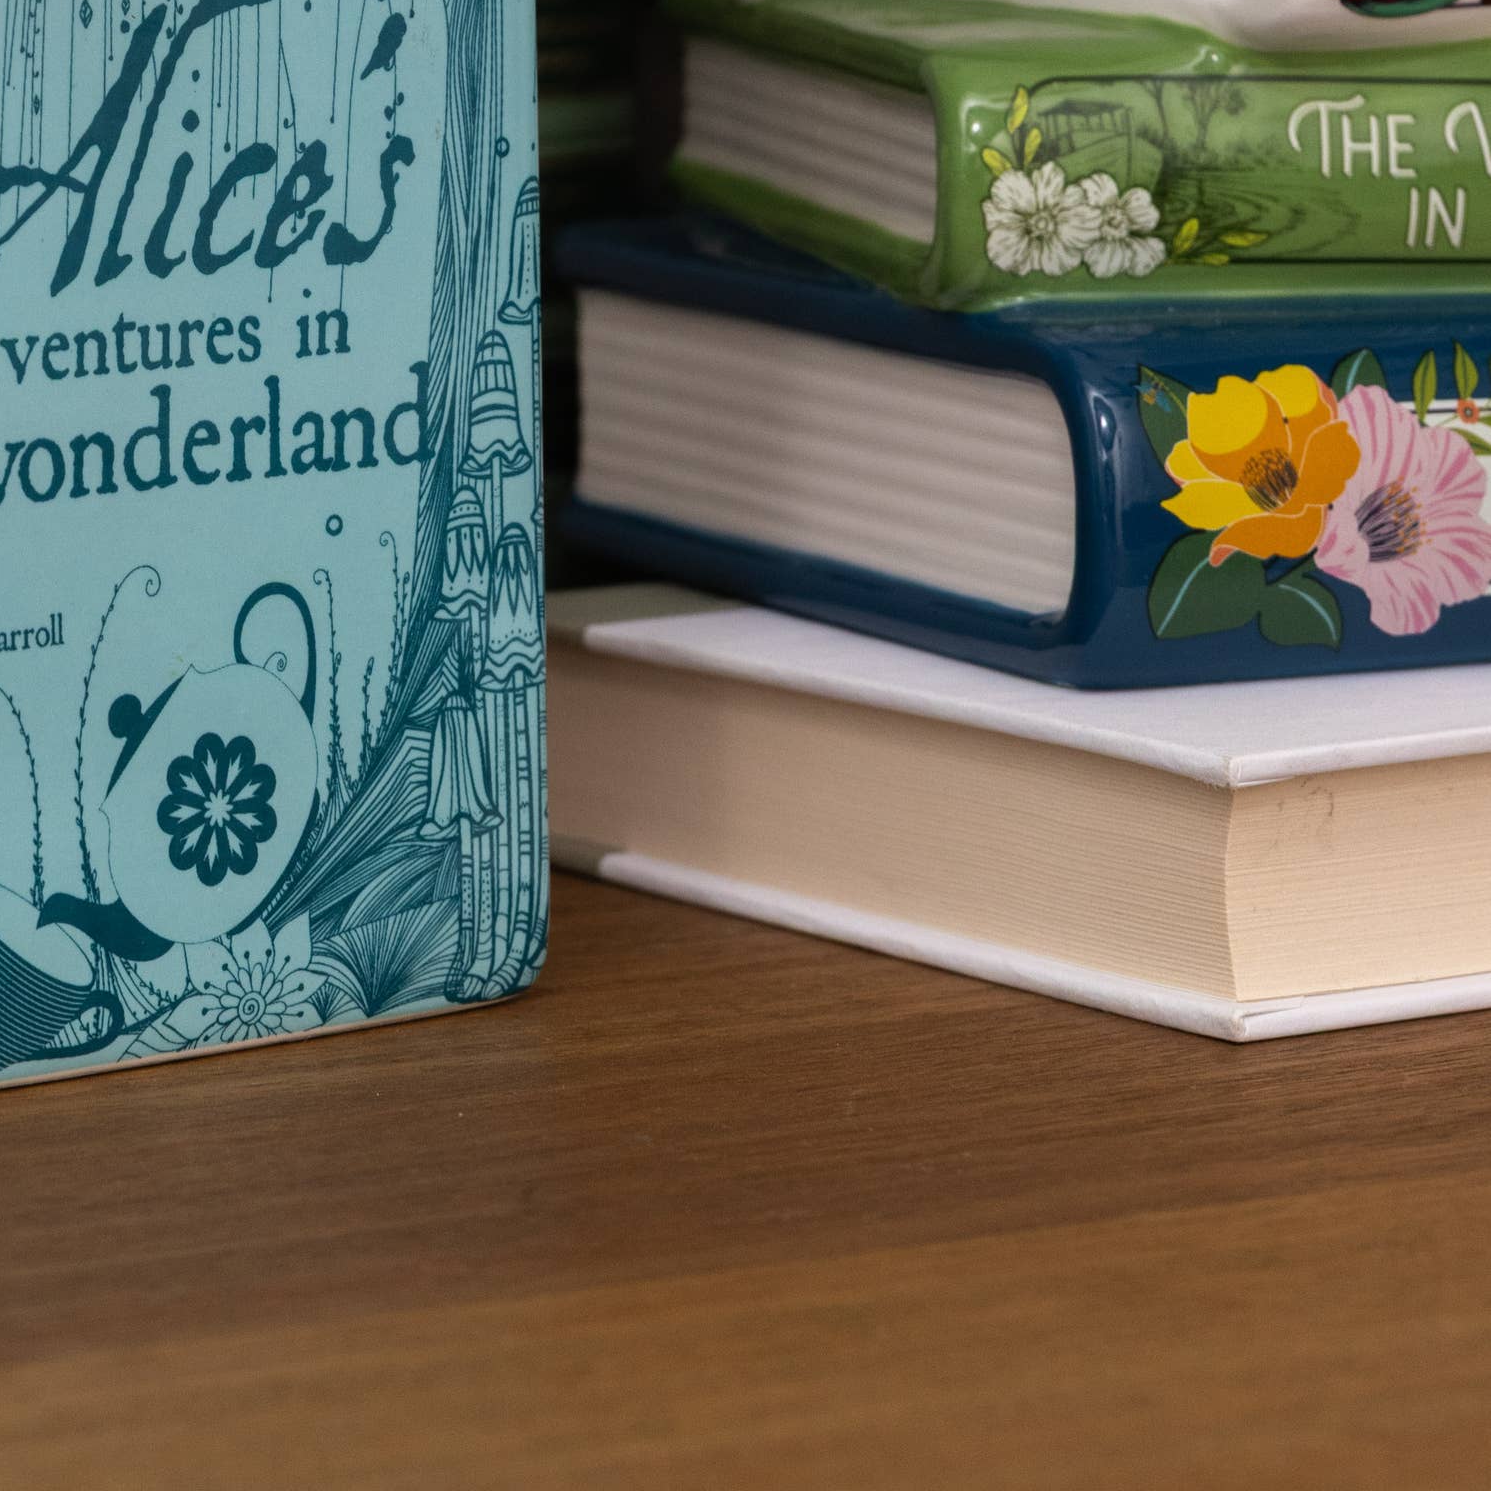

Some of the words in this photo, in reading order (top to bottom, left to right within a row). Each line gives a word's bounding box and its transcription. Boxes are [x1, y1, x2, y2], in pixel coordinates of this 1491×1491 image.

[1287, 93, 1417, 179] THE
[1407, 186, 1467, 249] IN
[296, 288, 351, 358] in
